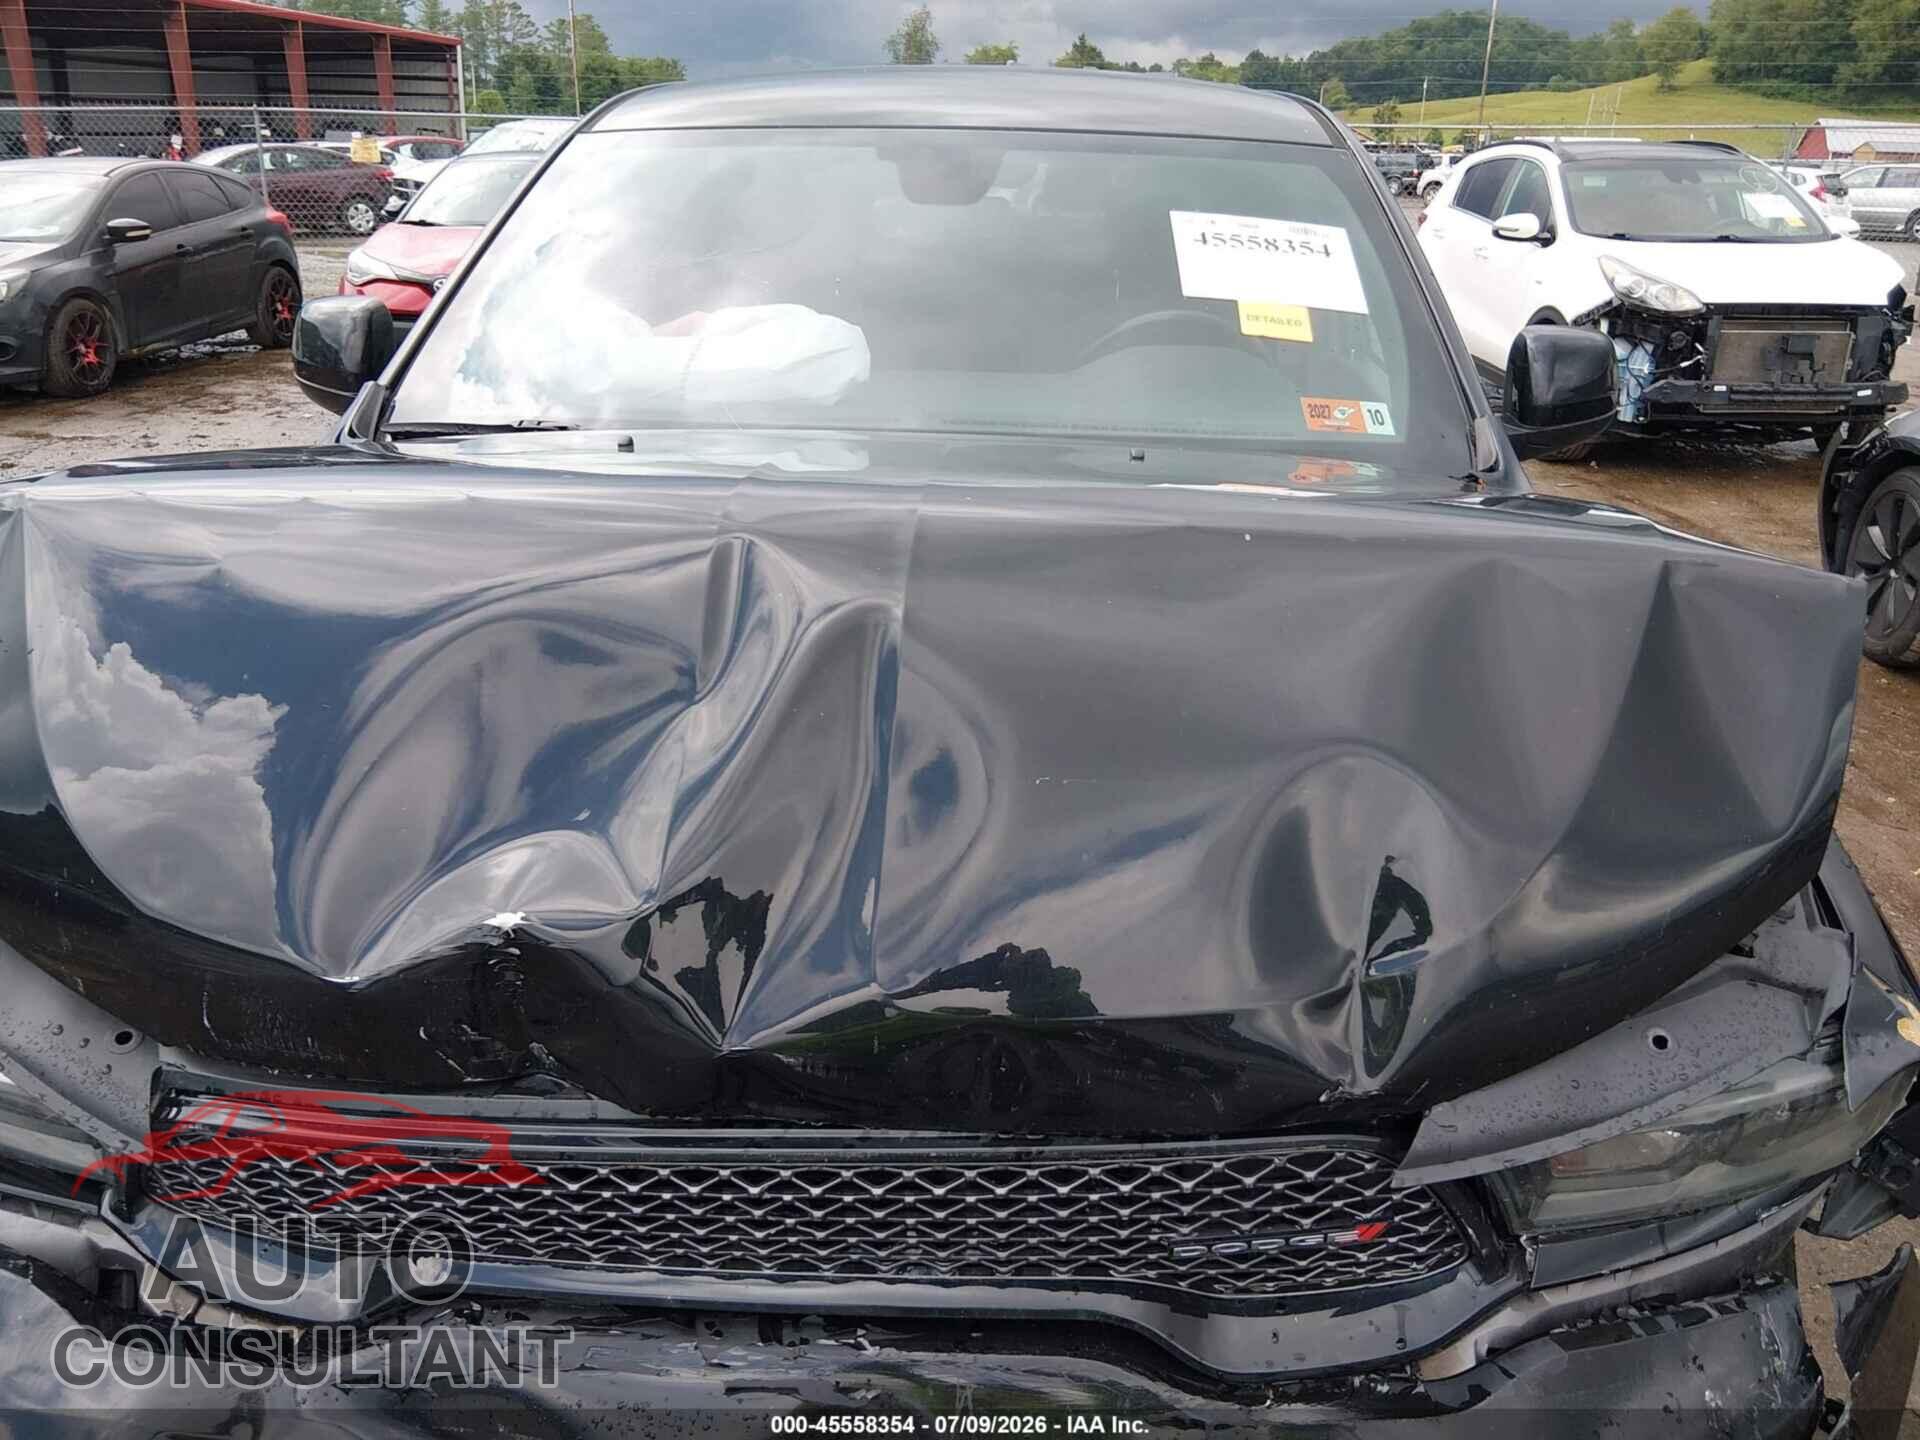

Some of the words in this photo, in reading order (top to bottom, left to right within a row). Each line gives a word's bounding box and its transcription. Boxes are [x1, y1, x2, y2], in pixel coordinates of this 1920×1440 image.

[1194, 231, 1331, 257] 45558354
[1246, 314, 1303, 327] DETAILED
[1367, 408, 1385, 426] 10
